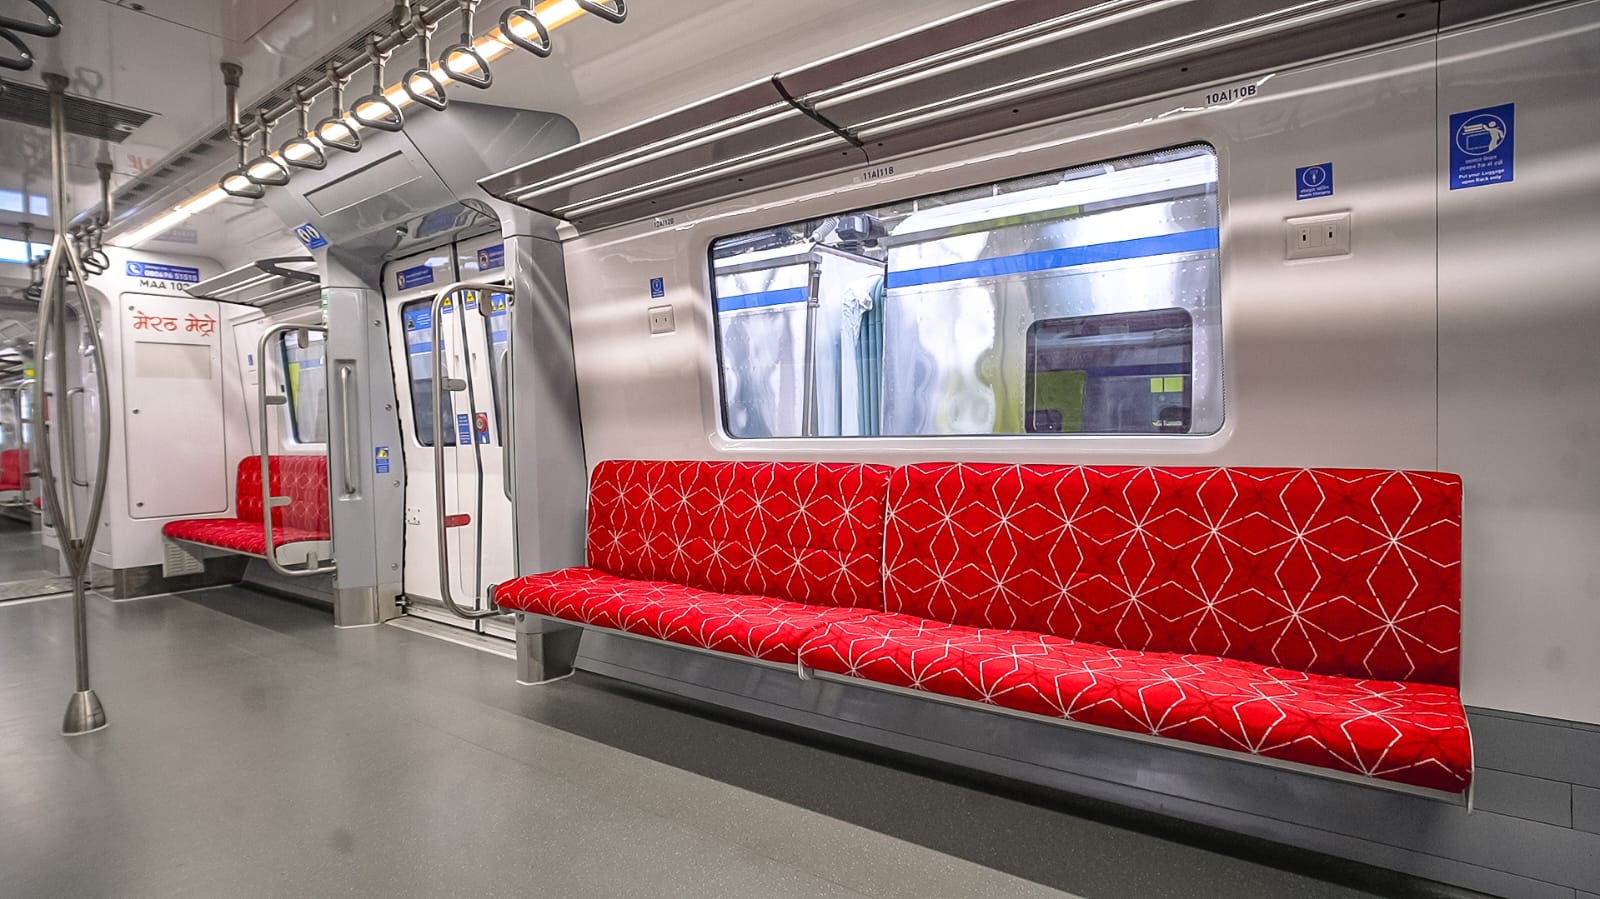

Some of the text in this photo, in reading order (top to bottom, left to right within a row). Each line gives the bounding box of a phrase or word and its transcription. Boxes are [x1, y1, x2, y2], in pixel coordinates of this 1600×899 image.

[140, 279, 167, 289] MAA
[132, 310, 217, 336] मेरठ मेट्रो
